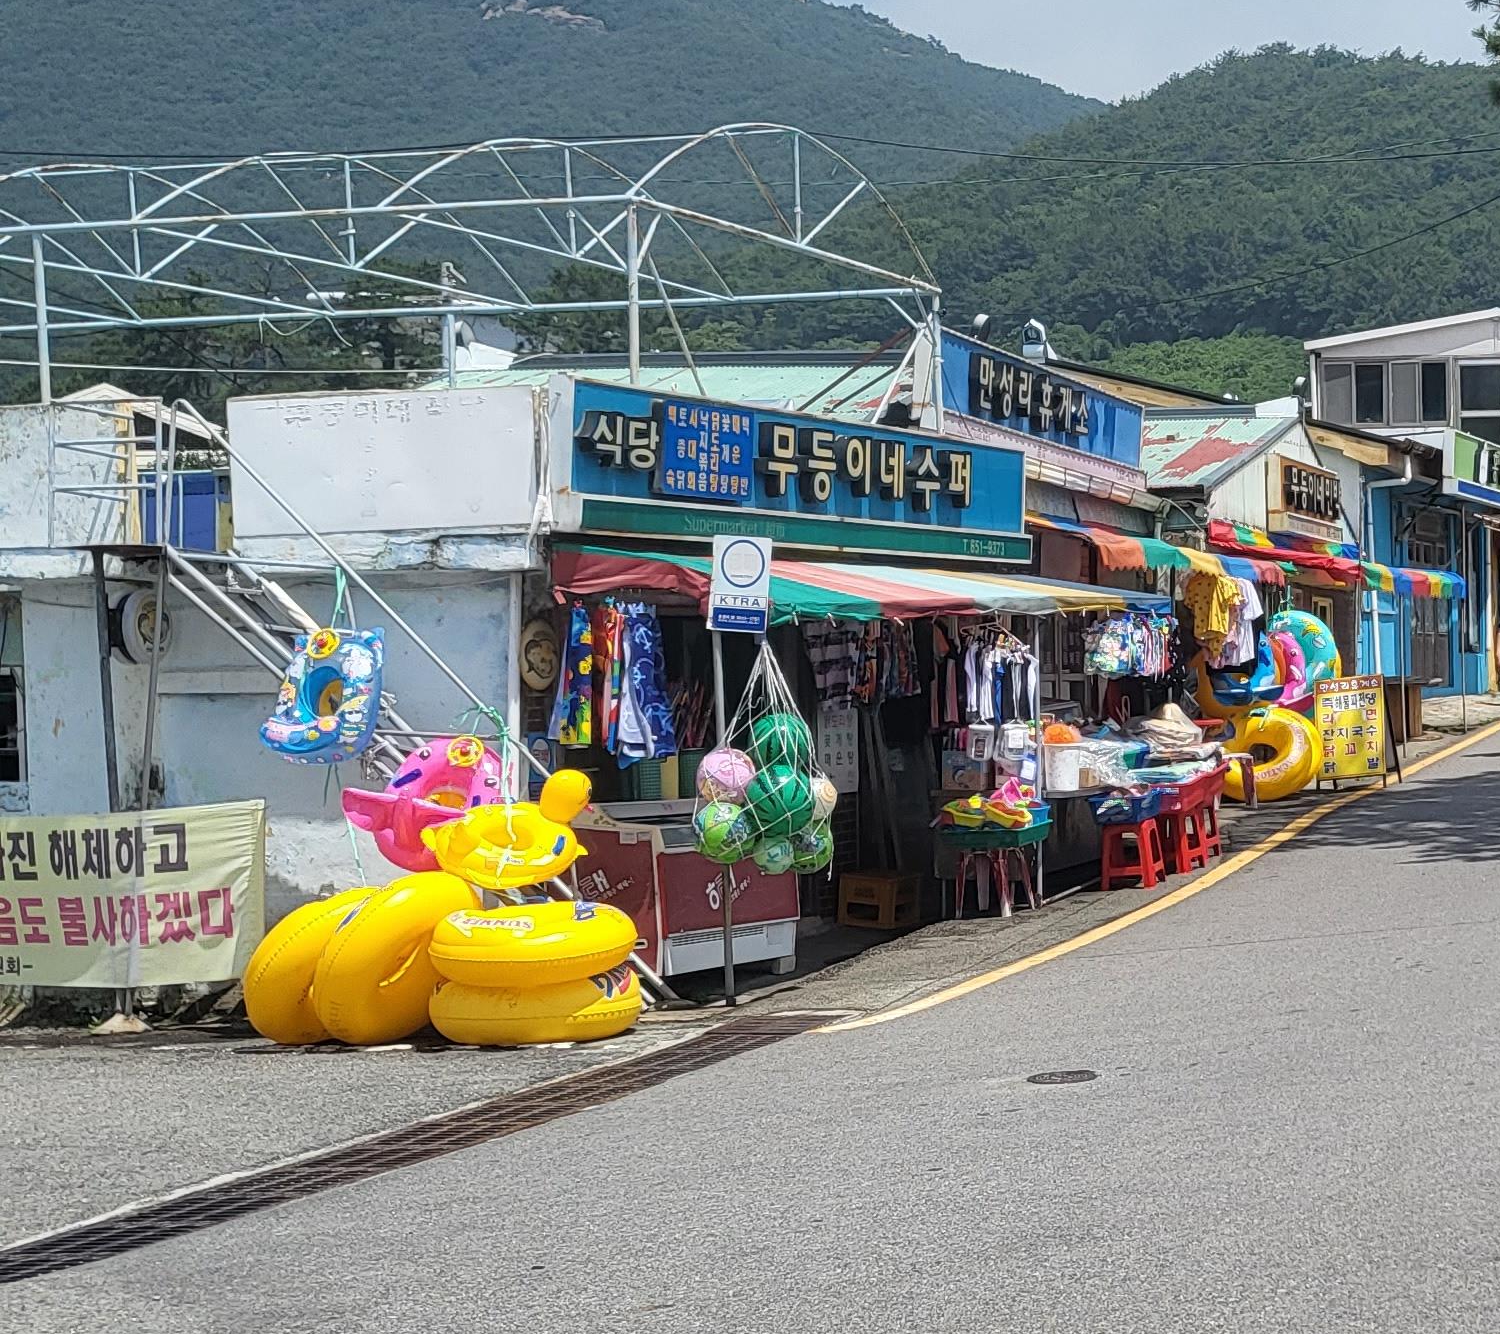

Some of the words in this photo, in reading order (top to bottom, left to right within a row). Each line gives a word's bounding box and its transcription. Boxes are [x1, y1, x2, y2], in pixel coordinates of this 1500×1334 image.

[979, 356, 1089, 435] 만성리휴게소
[592, 414, 661, 469] 식당
[767, 424, 972, 511] 무등이네수퍼
[684, 515, 758, 534] Supermarket
[719, 596, 761, 607] KTRA
[1319, 679, 1379, 693] 만성리휴게소
[0, 829, 38, 881] 진
[48, 823, 189, 880] 해체하고
[57, 887, 235, 947] 불사하겠다
